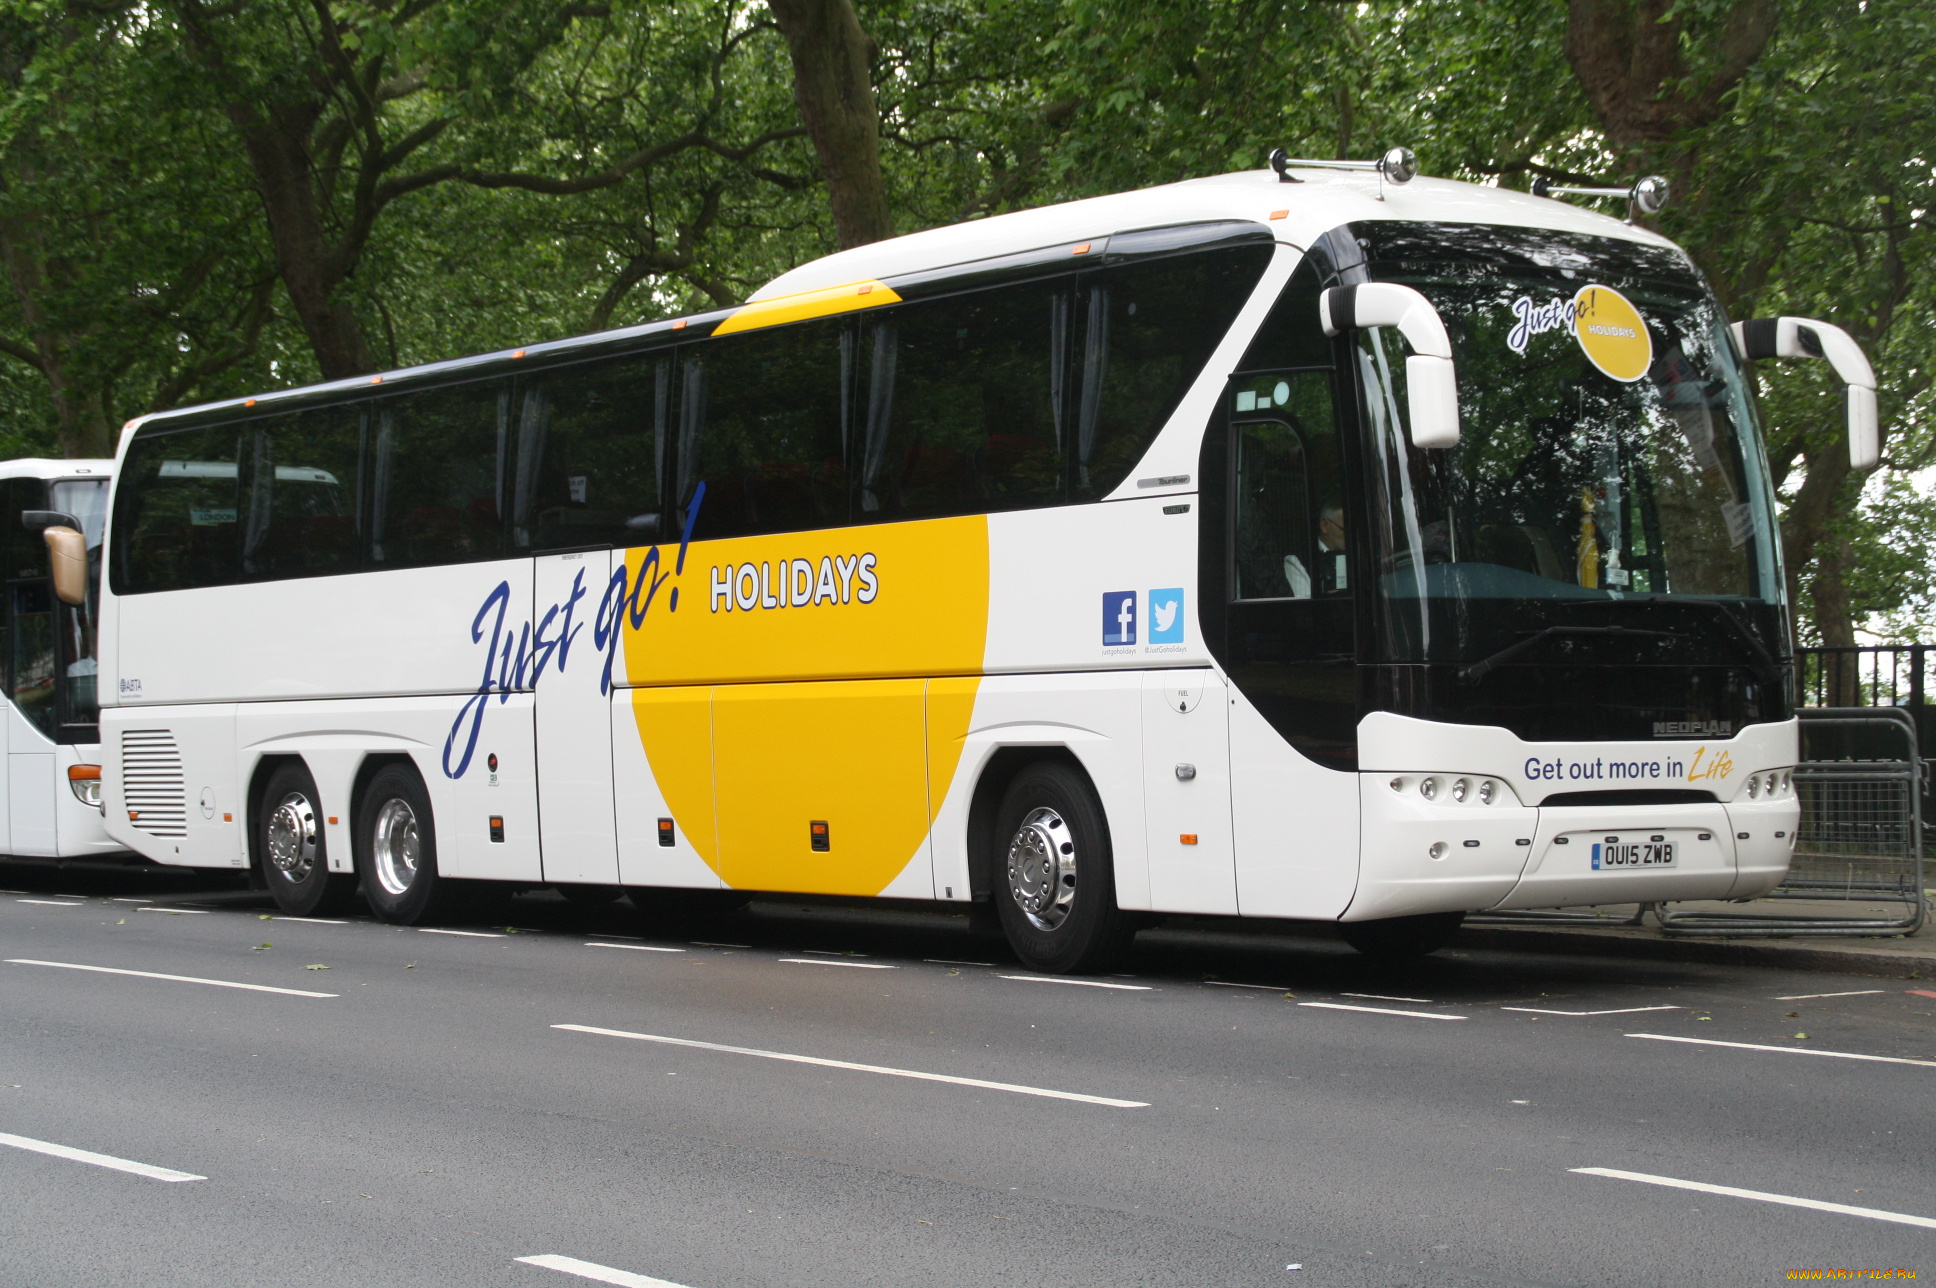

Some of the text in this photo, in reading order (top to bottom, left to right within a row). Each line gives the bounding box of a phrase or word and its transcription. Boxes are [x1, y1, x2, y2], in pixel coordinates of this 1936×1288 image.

[1511, 289, 1596, 349] Just go!
[1587, 324, 1637, 339] HOLIDAYS
[1157, 476, 1188, 485] Tourliner
[710, 552, 878, 613] HOLIDAYS
[442, 481, 706, 780] Just go!
[1101, 647, 1136, 657] justgoholidays
[126, 679, 142, 691] ABTA
[1653, 720, 1731, 737] NEOPLAN
[1524, 746, 1734, 782] Get out more in Life
[1605, 844, 1672, 865] OU15 ZWB
